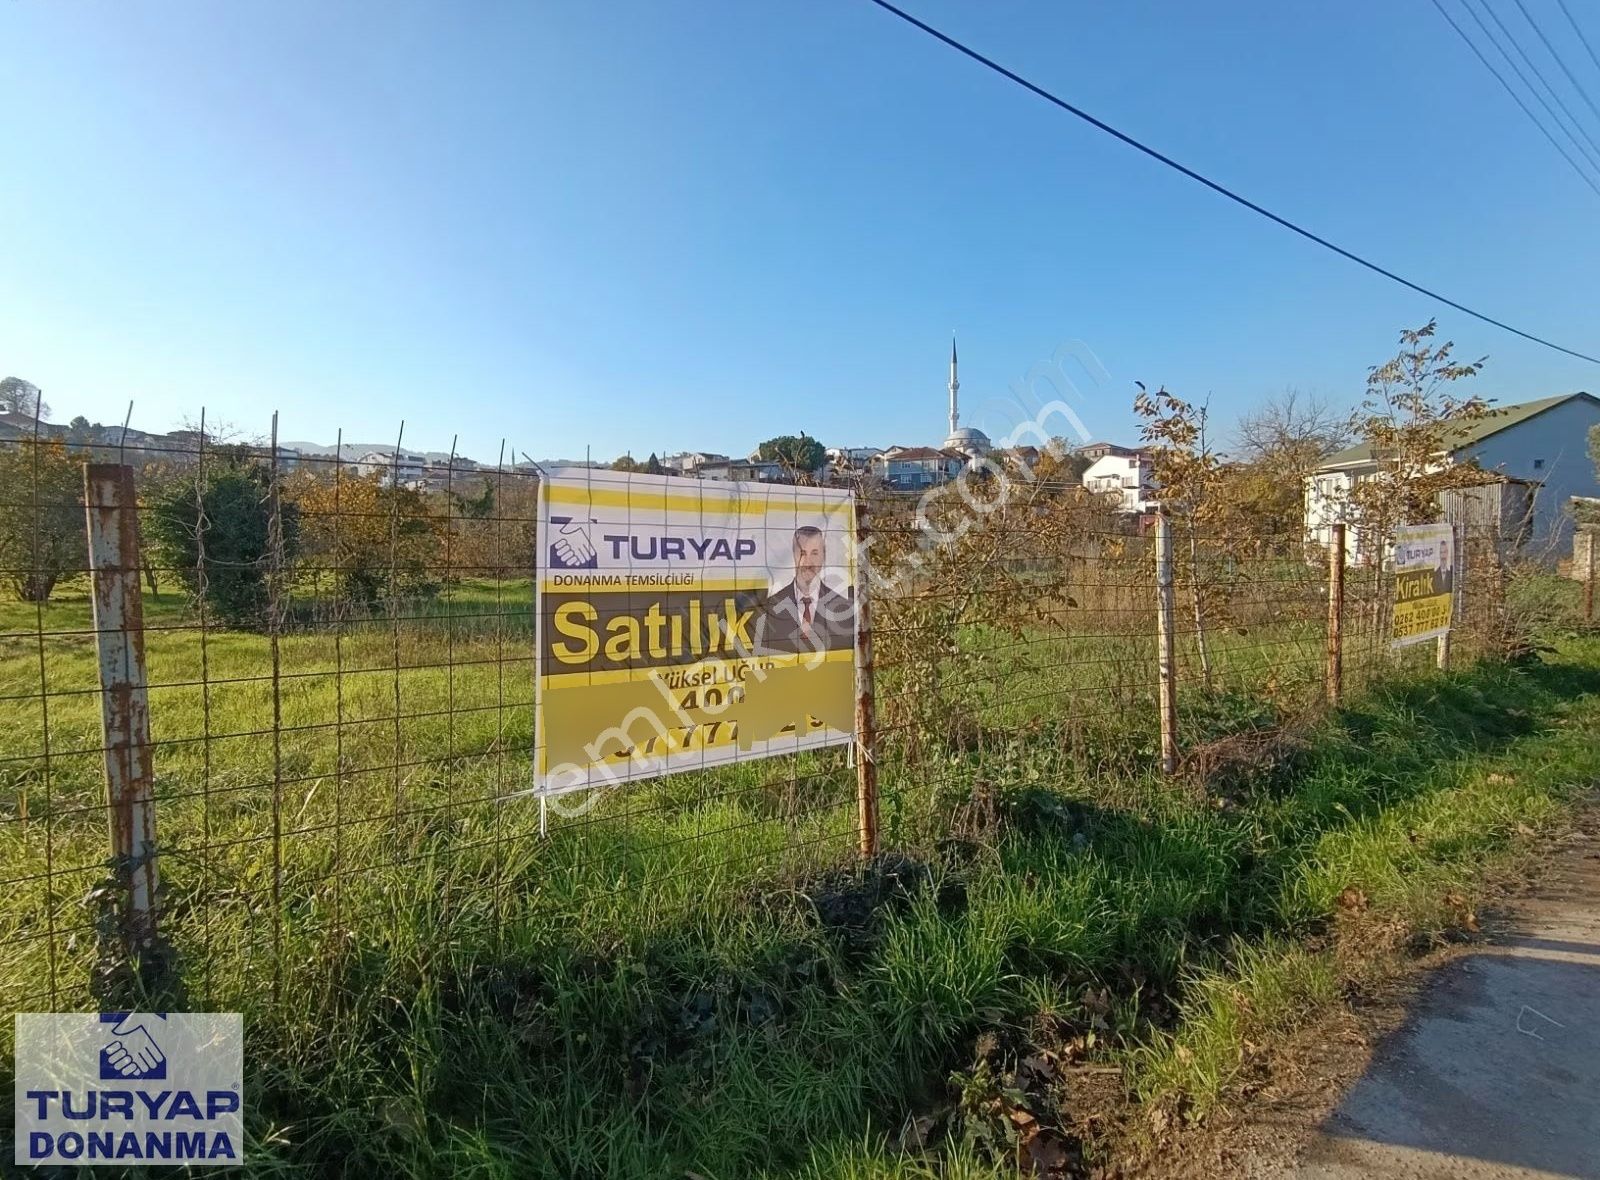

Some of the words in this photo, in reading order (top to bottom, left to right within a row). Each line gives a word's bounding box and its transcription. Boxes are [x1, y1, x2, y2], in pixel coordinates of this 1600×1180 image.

[603, 534, 757, 562] TURYAP
[553, 574, 622, 587] DONANMA
[625, 572, 695, 587] TEMSİLCİLİĞİ
[1396, 573, 1434, 600] Kiralık
[551, 598, 755, 665] Satılık
